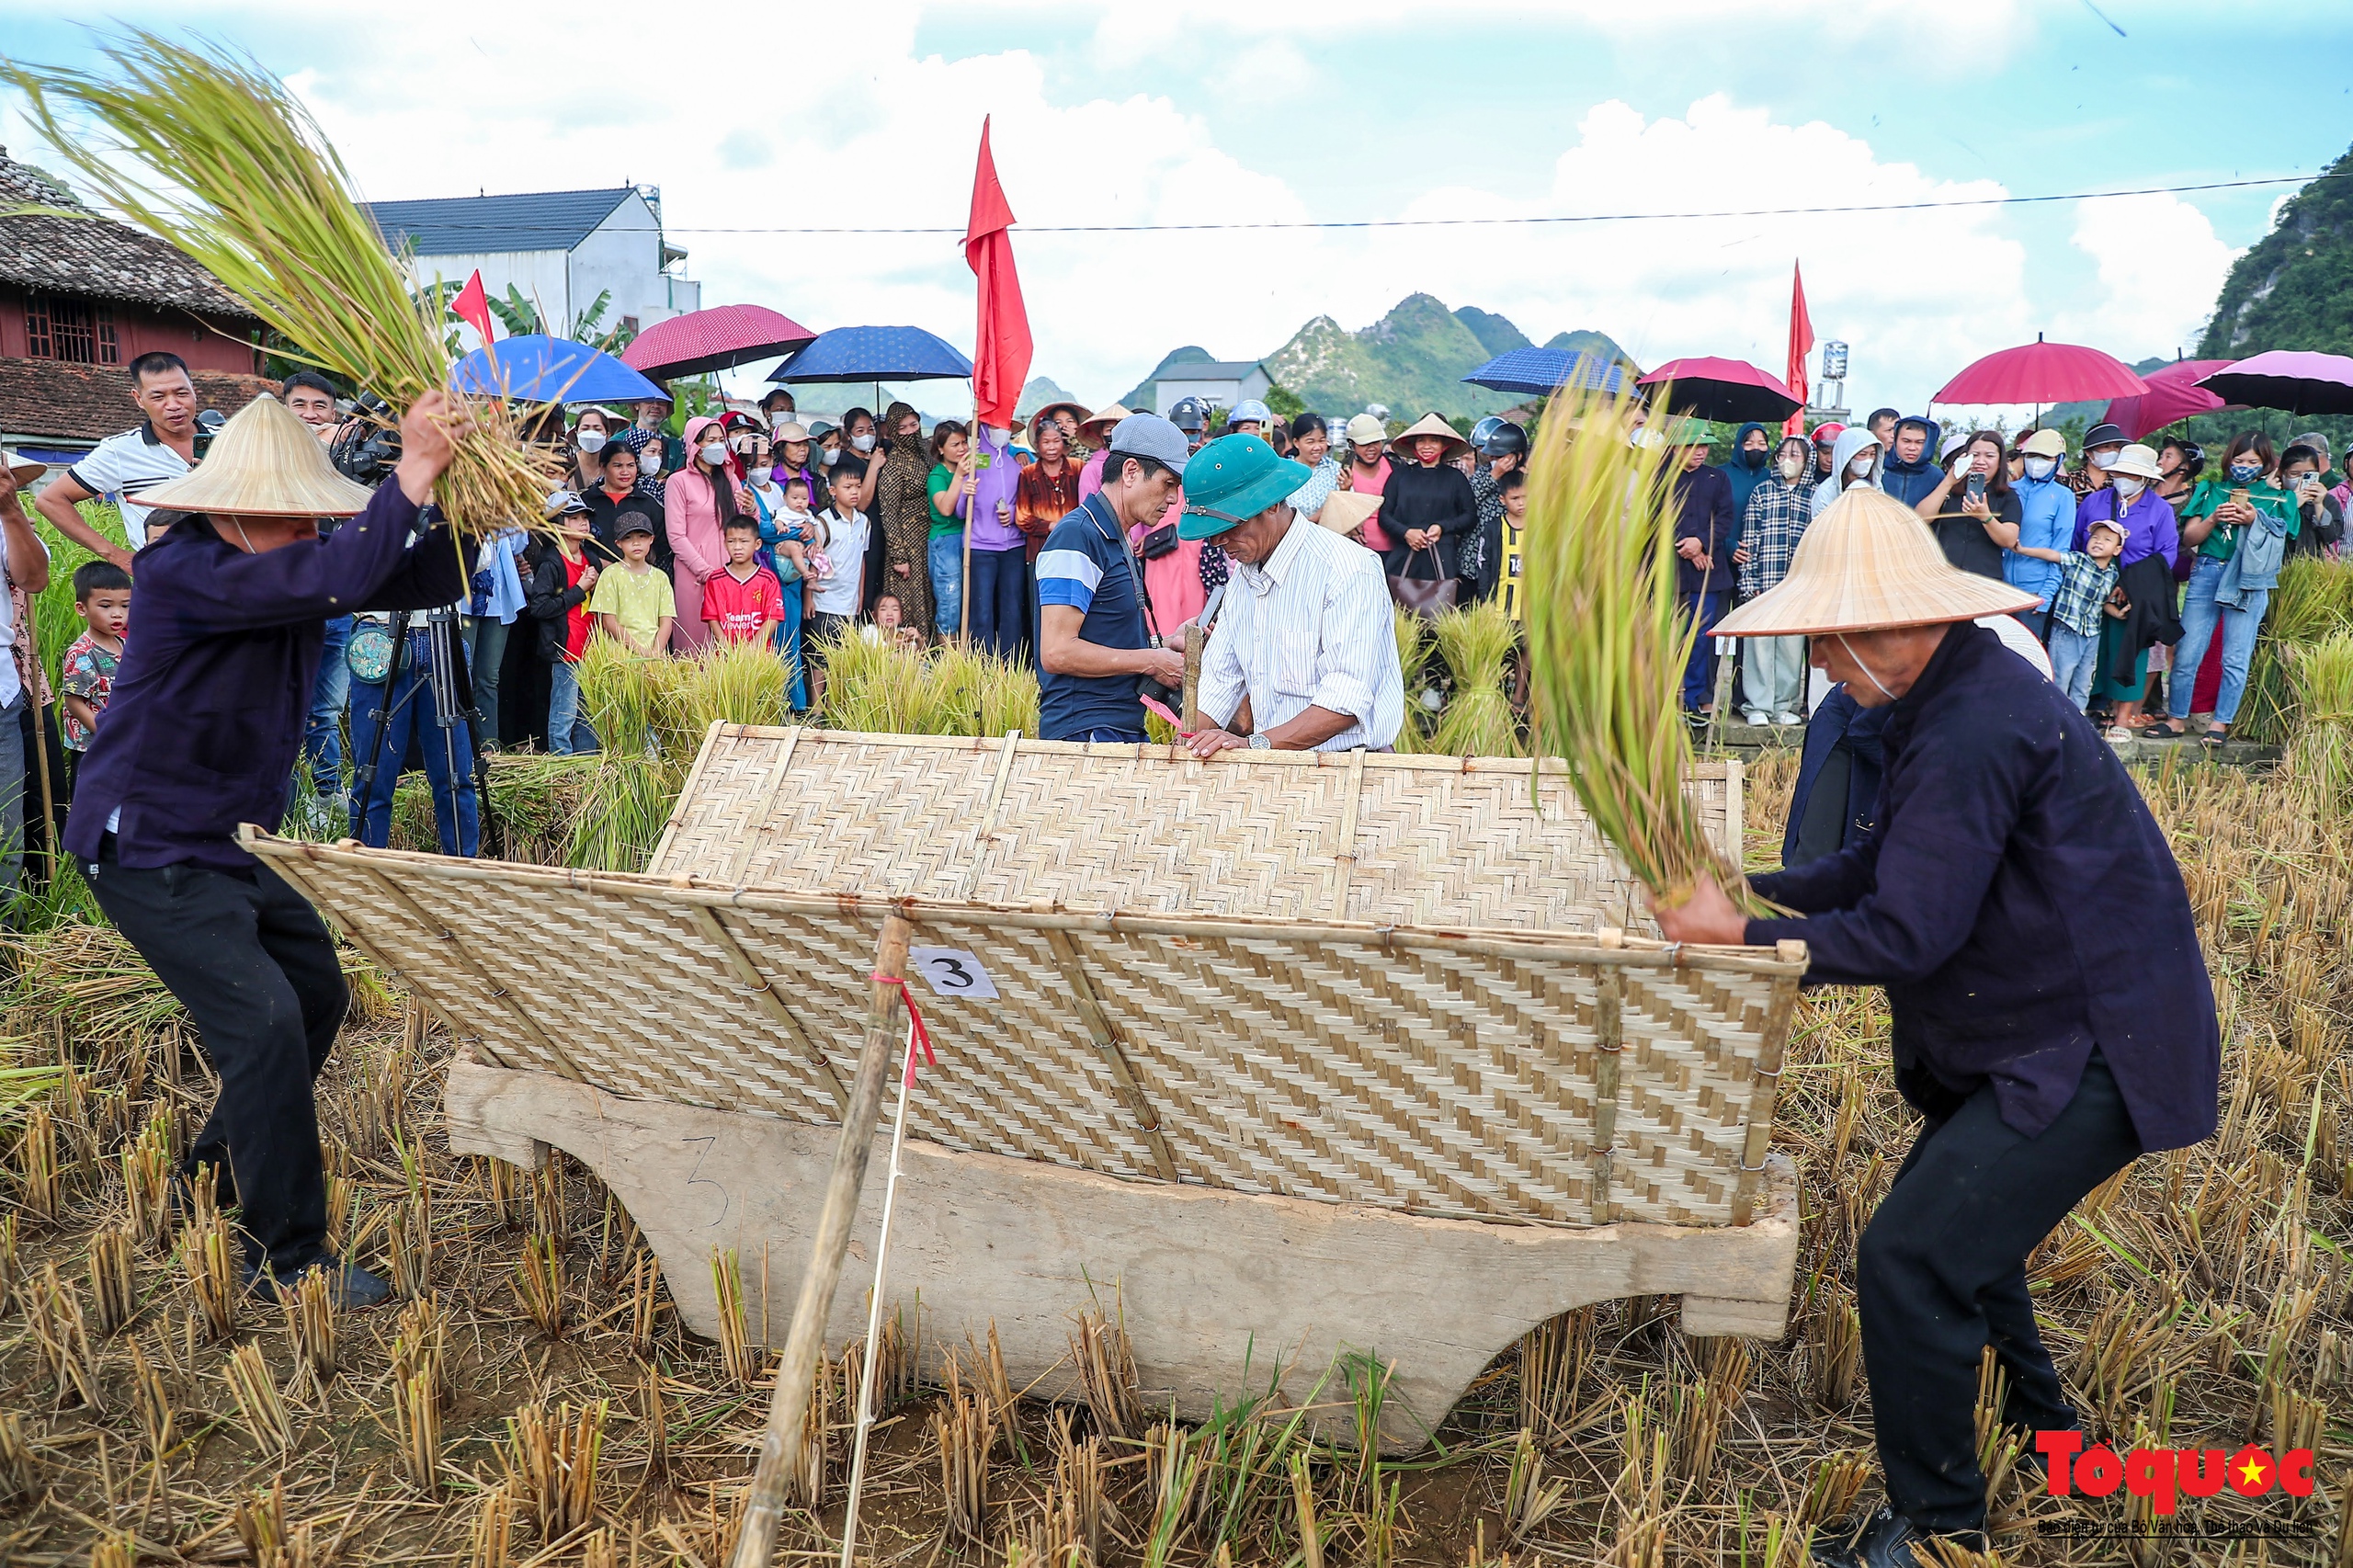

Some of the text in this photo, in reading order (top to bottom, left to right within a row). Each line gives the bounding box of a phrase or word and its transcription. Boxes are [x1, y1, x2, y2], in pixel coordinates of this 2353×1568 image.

[1509, 558, 1524, 573] 18
[725, 612, 751, 622] Team
[931, 958, 974, 988] 3
